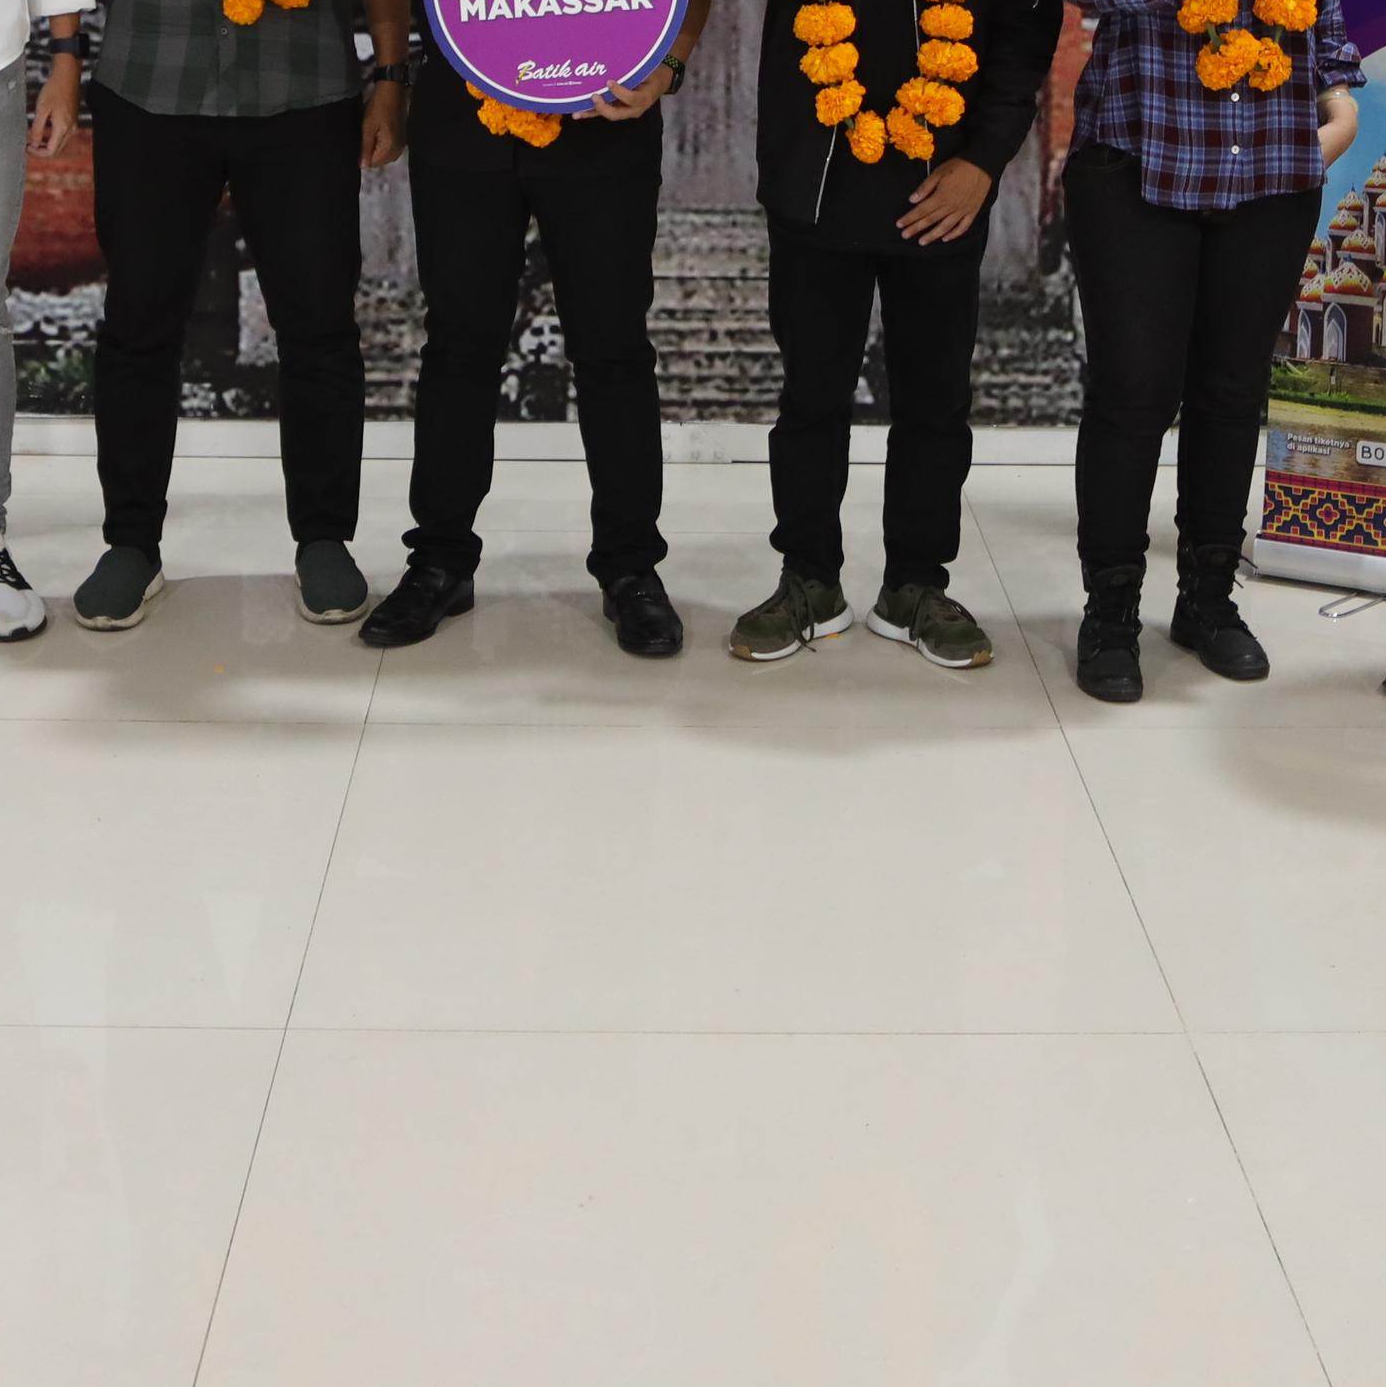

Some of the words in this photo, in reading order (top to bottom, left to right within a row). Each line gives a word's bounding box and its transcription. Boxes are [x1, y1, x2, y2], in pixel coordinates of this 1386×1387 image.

[516, 59, 573, 81] Batik
[574, 61, 607, 77] air
[1286, 442, 1297, 451] di
[1297, 443, 1332, 456] aplikasi
[1313, 435, 1350, 450] tiketnya
